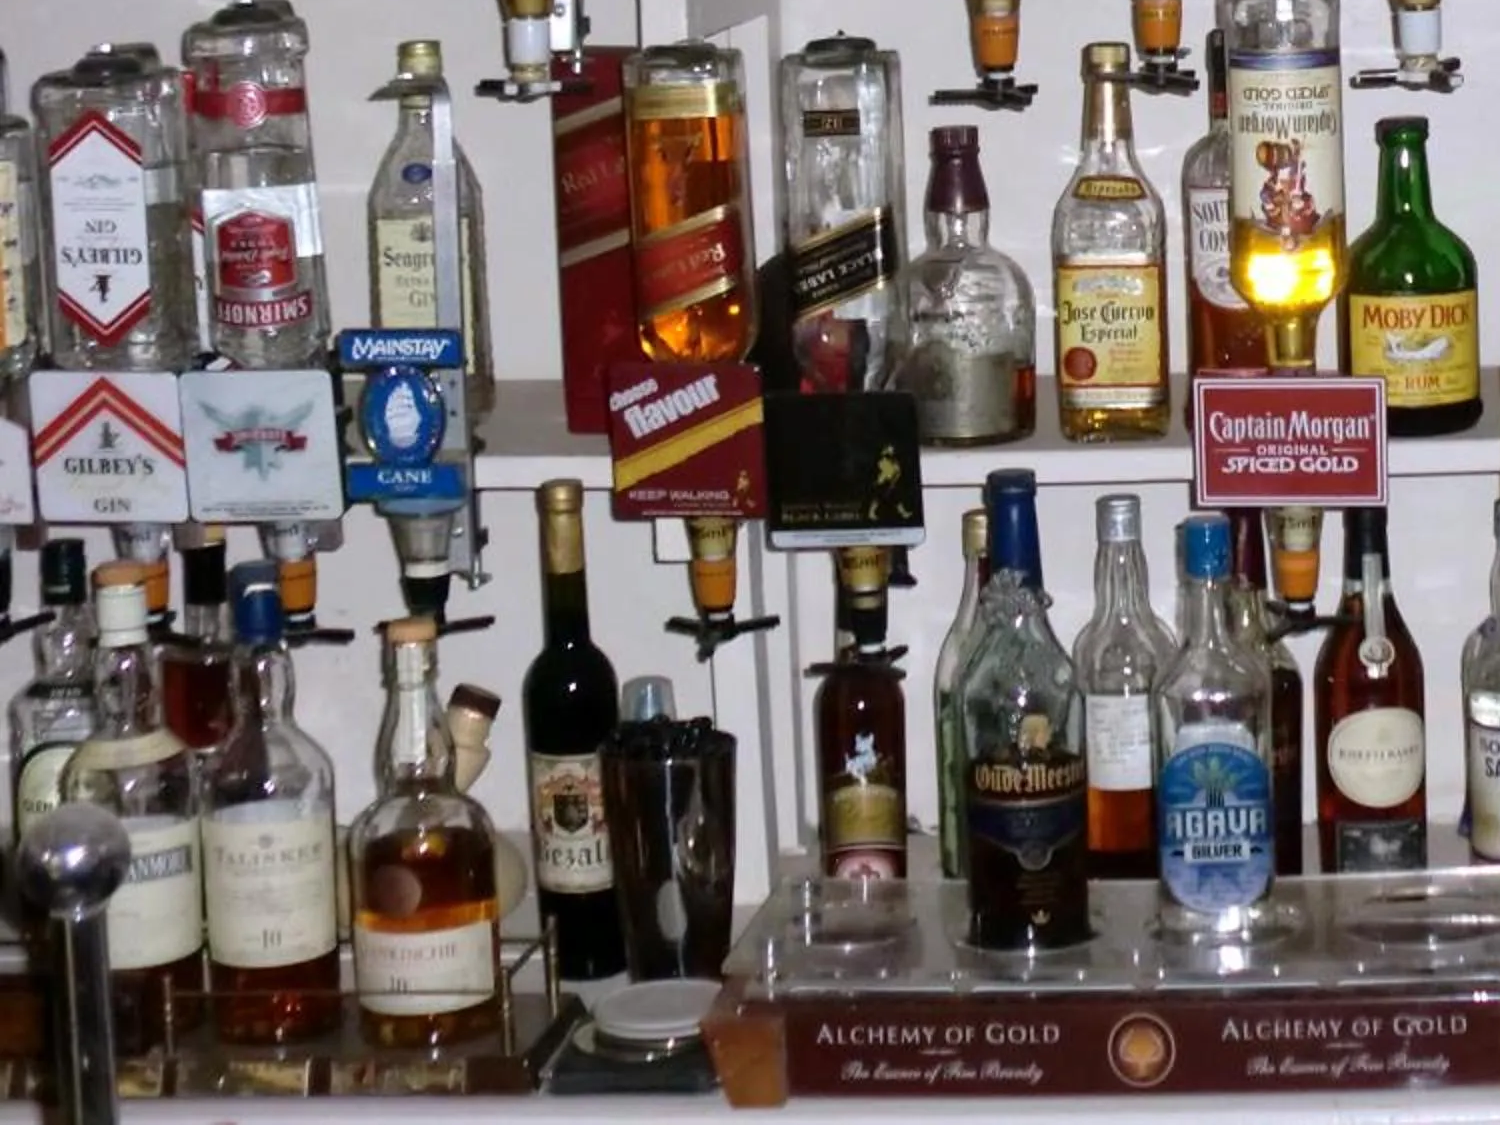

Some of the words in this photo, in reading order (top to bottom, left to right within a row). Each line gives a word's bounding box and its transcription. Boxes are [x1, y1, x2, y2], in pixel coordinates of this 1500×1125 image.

[1243, 87, 1282, 100] GOLD
[1237, 113, 1291, 141] Morgan
[1293, 113, 1338, 140] Captain
[84, 220, 119, 235] GIN
[60, 246, 143, 269] GILBEY'S
[1362, 303, 1425, 330] MOBY
[1430, 303, 1472, 325] DICK
[352, 337, 448, 360] MAINSTAY
[610, 377, 660, 412] choose
[1404, 376, 1442, 390] RUM
[622, 375, 721, 440] flavour
[1208, 410, 1288, 444] Captain
[1287, 410, 1372, 445] Morgan
[1256, 443, 1329, 456] ORIGINAL
[63, 453, 156, 476] GILBEY'S
[376, 467, 433, 485] CANE
[1221, 456, 1297, 474] SPICED
[1299, 455, 1360, 474] GOLD
[93, 497, 131, 513] GIN
[628, 490, 667, 502] KEEP
[1166, 808, 1267, 839] AGAVA
[816, 1023, 935, 1047] ALCHEMY
[944, 1024, 977, 1045] OF
[985, 1022, 1061, 1045] GOLD
[1221, 1016, 1342, 1042] ALCHEMY
[1351, 1017, 1384, 1038] OF
[1392, 1015, 1467, 1037] GOLD
[841, 1061, 872, 1081] The
[925, 1061, 942, 1085] of
